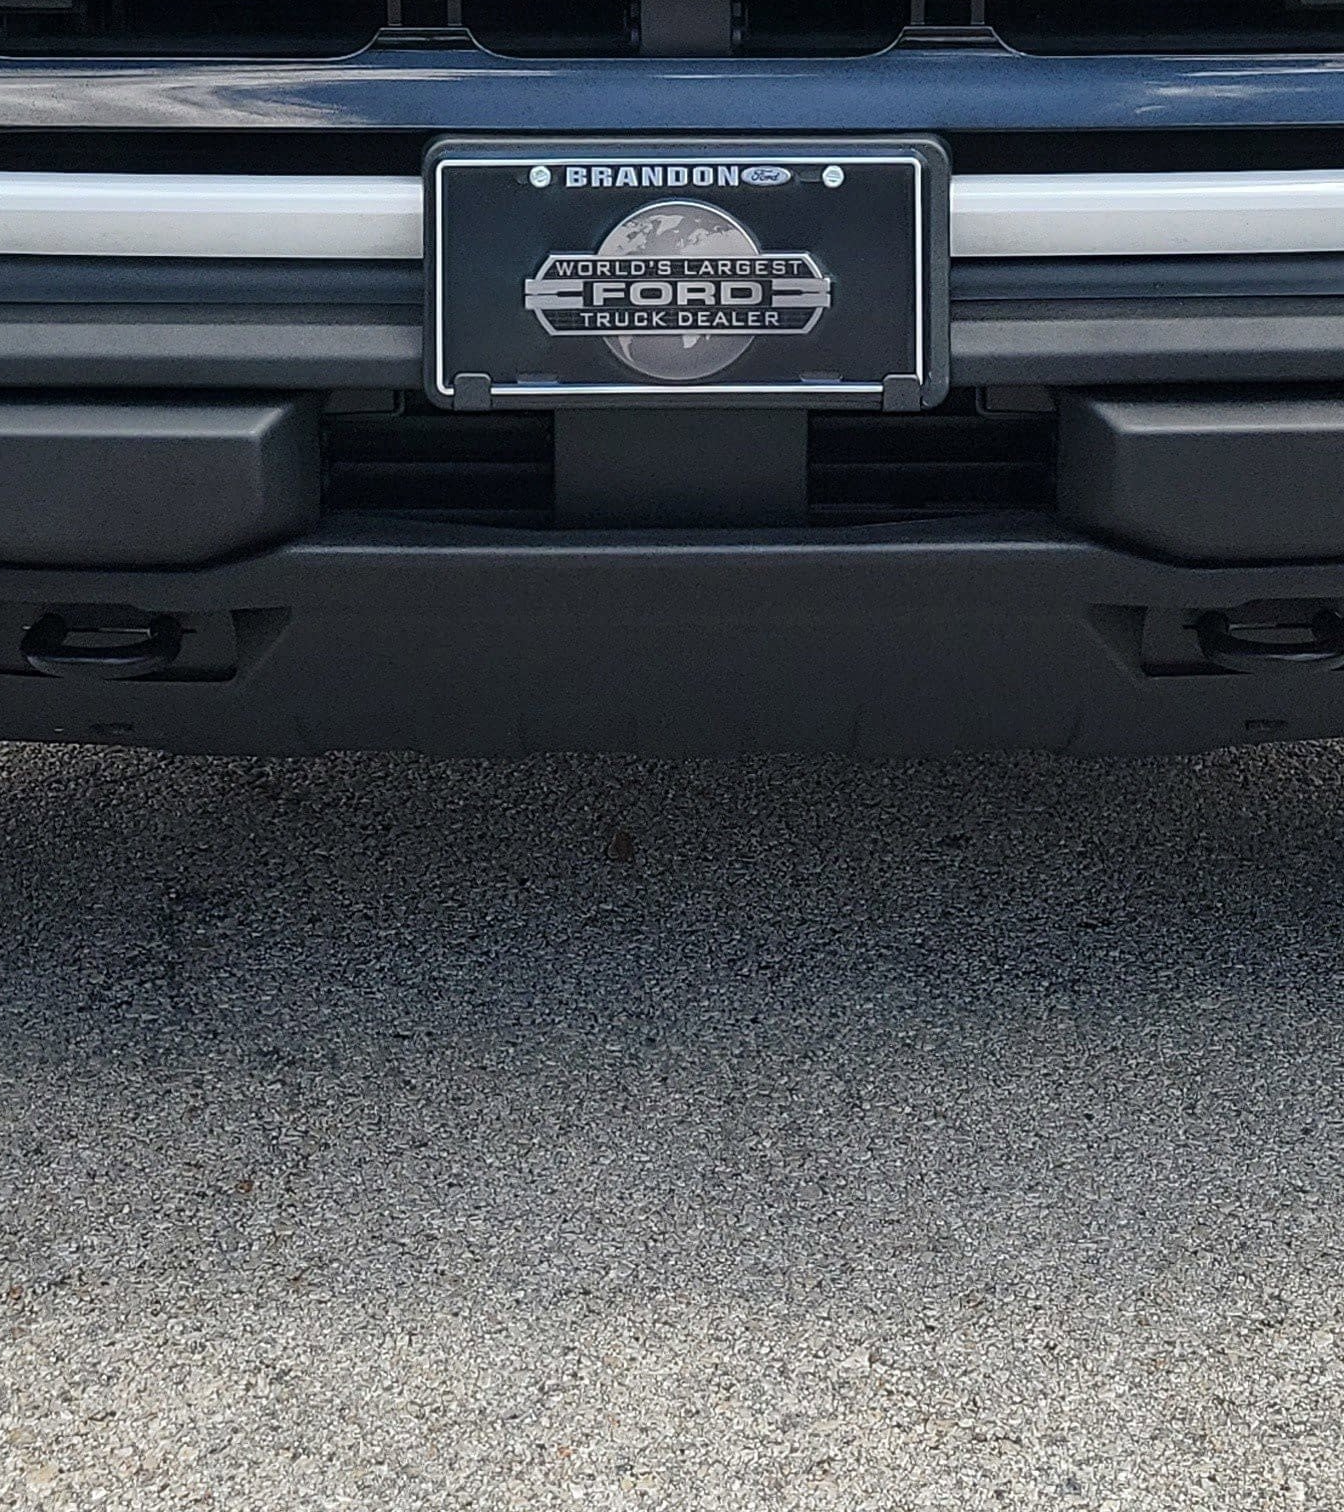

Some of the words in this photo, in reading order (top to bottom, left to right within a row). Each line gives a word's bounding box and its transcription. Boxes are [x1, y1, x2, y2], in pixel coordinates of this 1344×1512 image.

[566, 166, 739, 187] BRANDON
[556, 261, 672, 276] WORLD'S
[684, 260, 802, 276] LARGEST
[592, 281, 763, 306] FORD
[580, 311, 667, 327] TRUCK
[678, 311, 780, 327] DEALER
